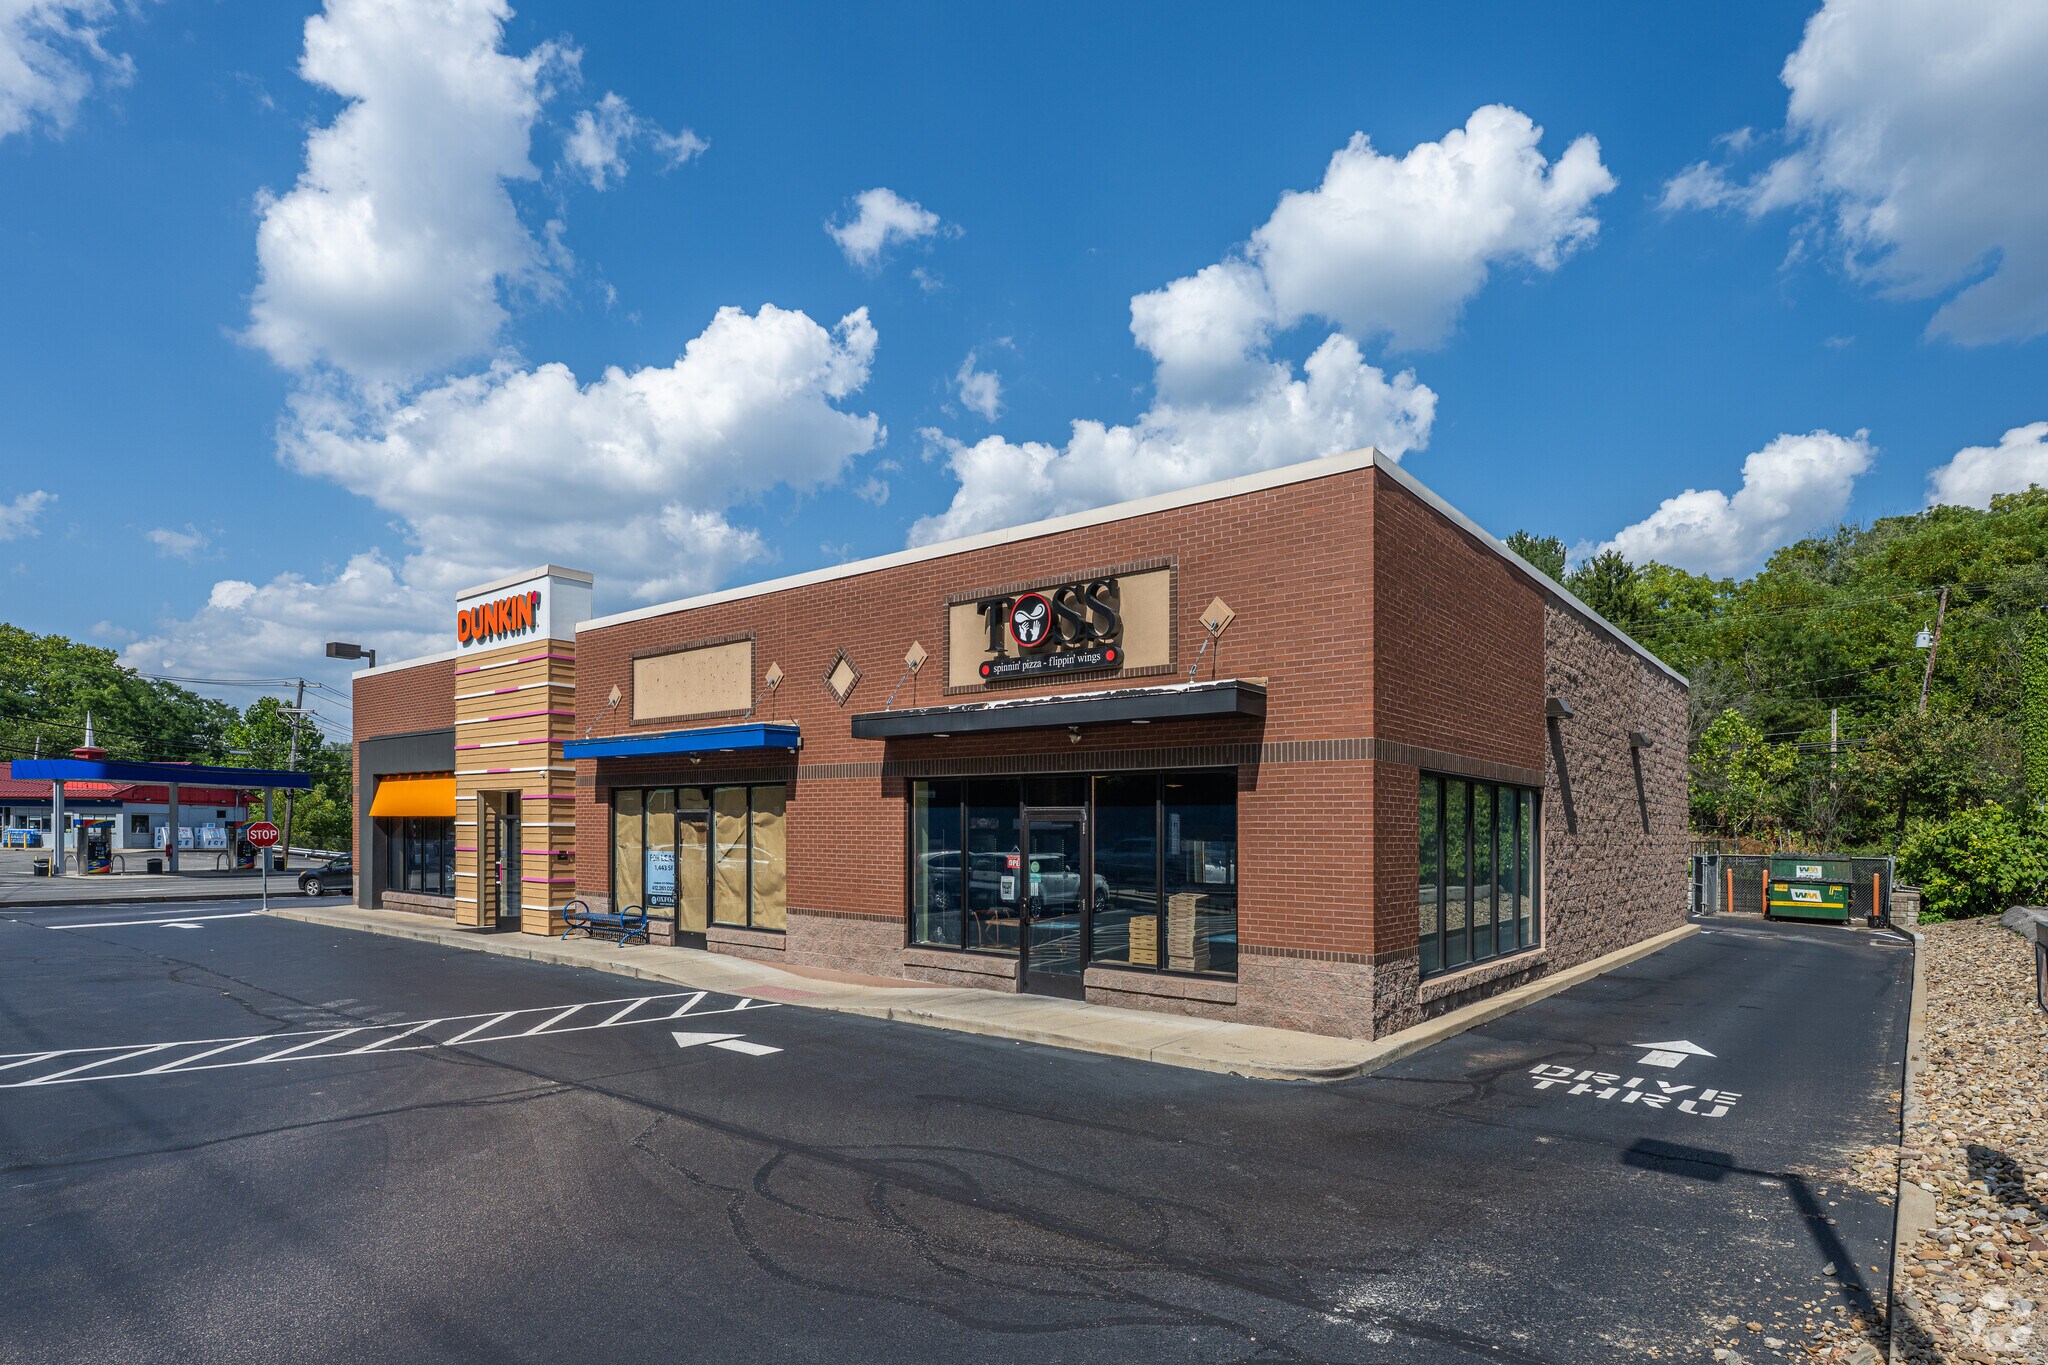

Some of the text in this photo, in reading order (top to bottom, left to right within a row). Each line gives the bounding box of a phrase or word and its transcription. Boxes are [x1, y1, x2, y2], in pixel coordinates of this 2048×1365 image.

[457, 590, 537, 643] DUNKIN'
[976, 578, 1119, 653] TOSS
[993, 660, 1021, 674] spinnin'
[1022, 660, 1042, 671] pizza
[1048, 654, 1076, 667] flippin'
[1077, 652, 1101, 663] wings
[250, 829, 277, 840] STOP
[661, 854, 675, 862] LEAS
[1795, 892, 1818, 900] WM
[1528, 1063, 1743, 1106] DRIVE
[1531, 1076, 1729, 1118] THRU
